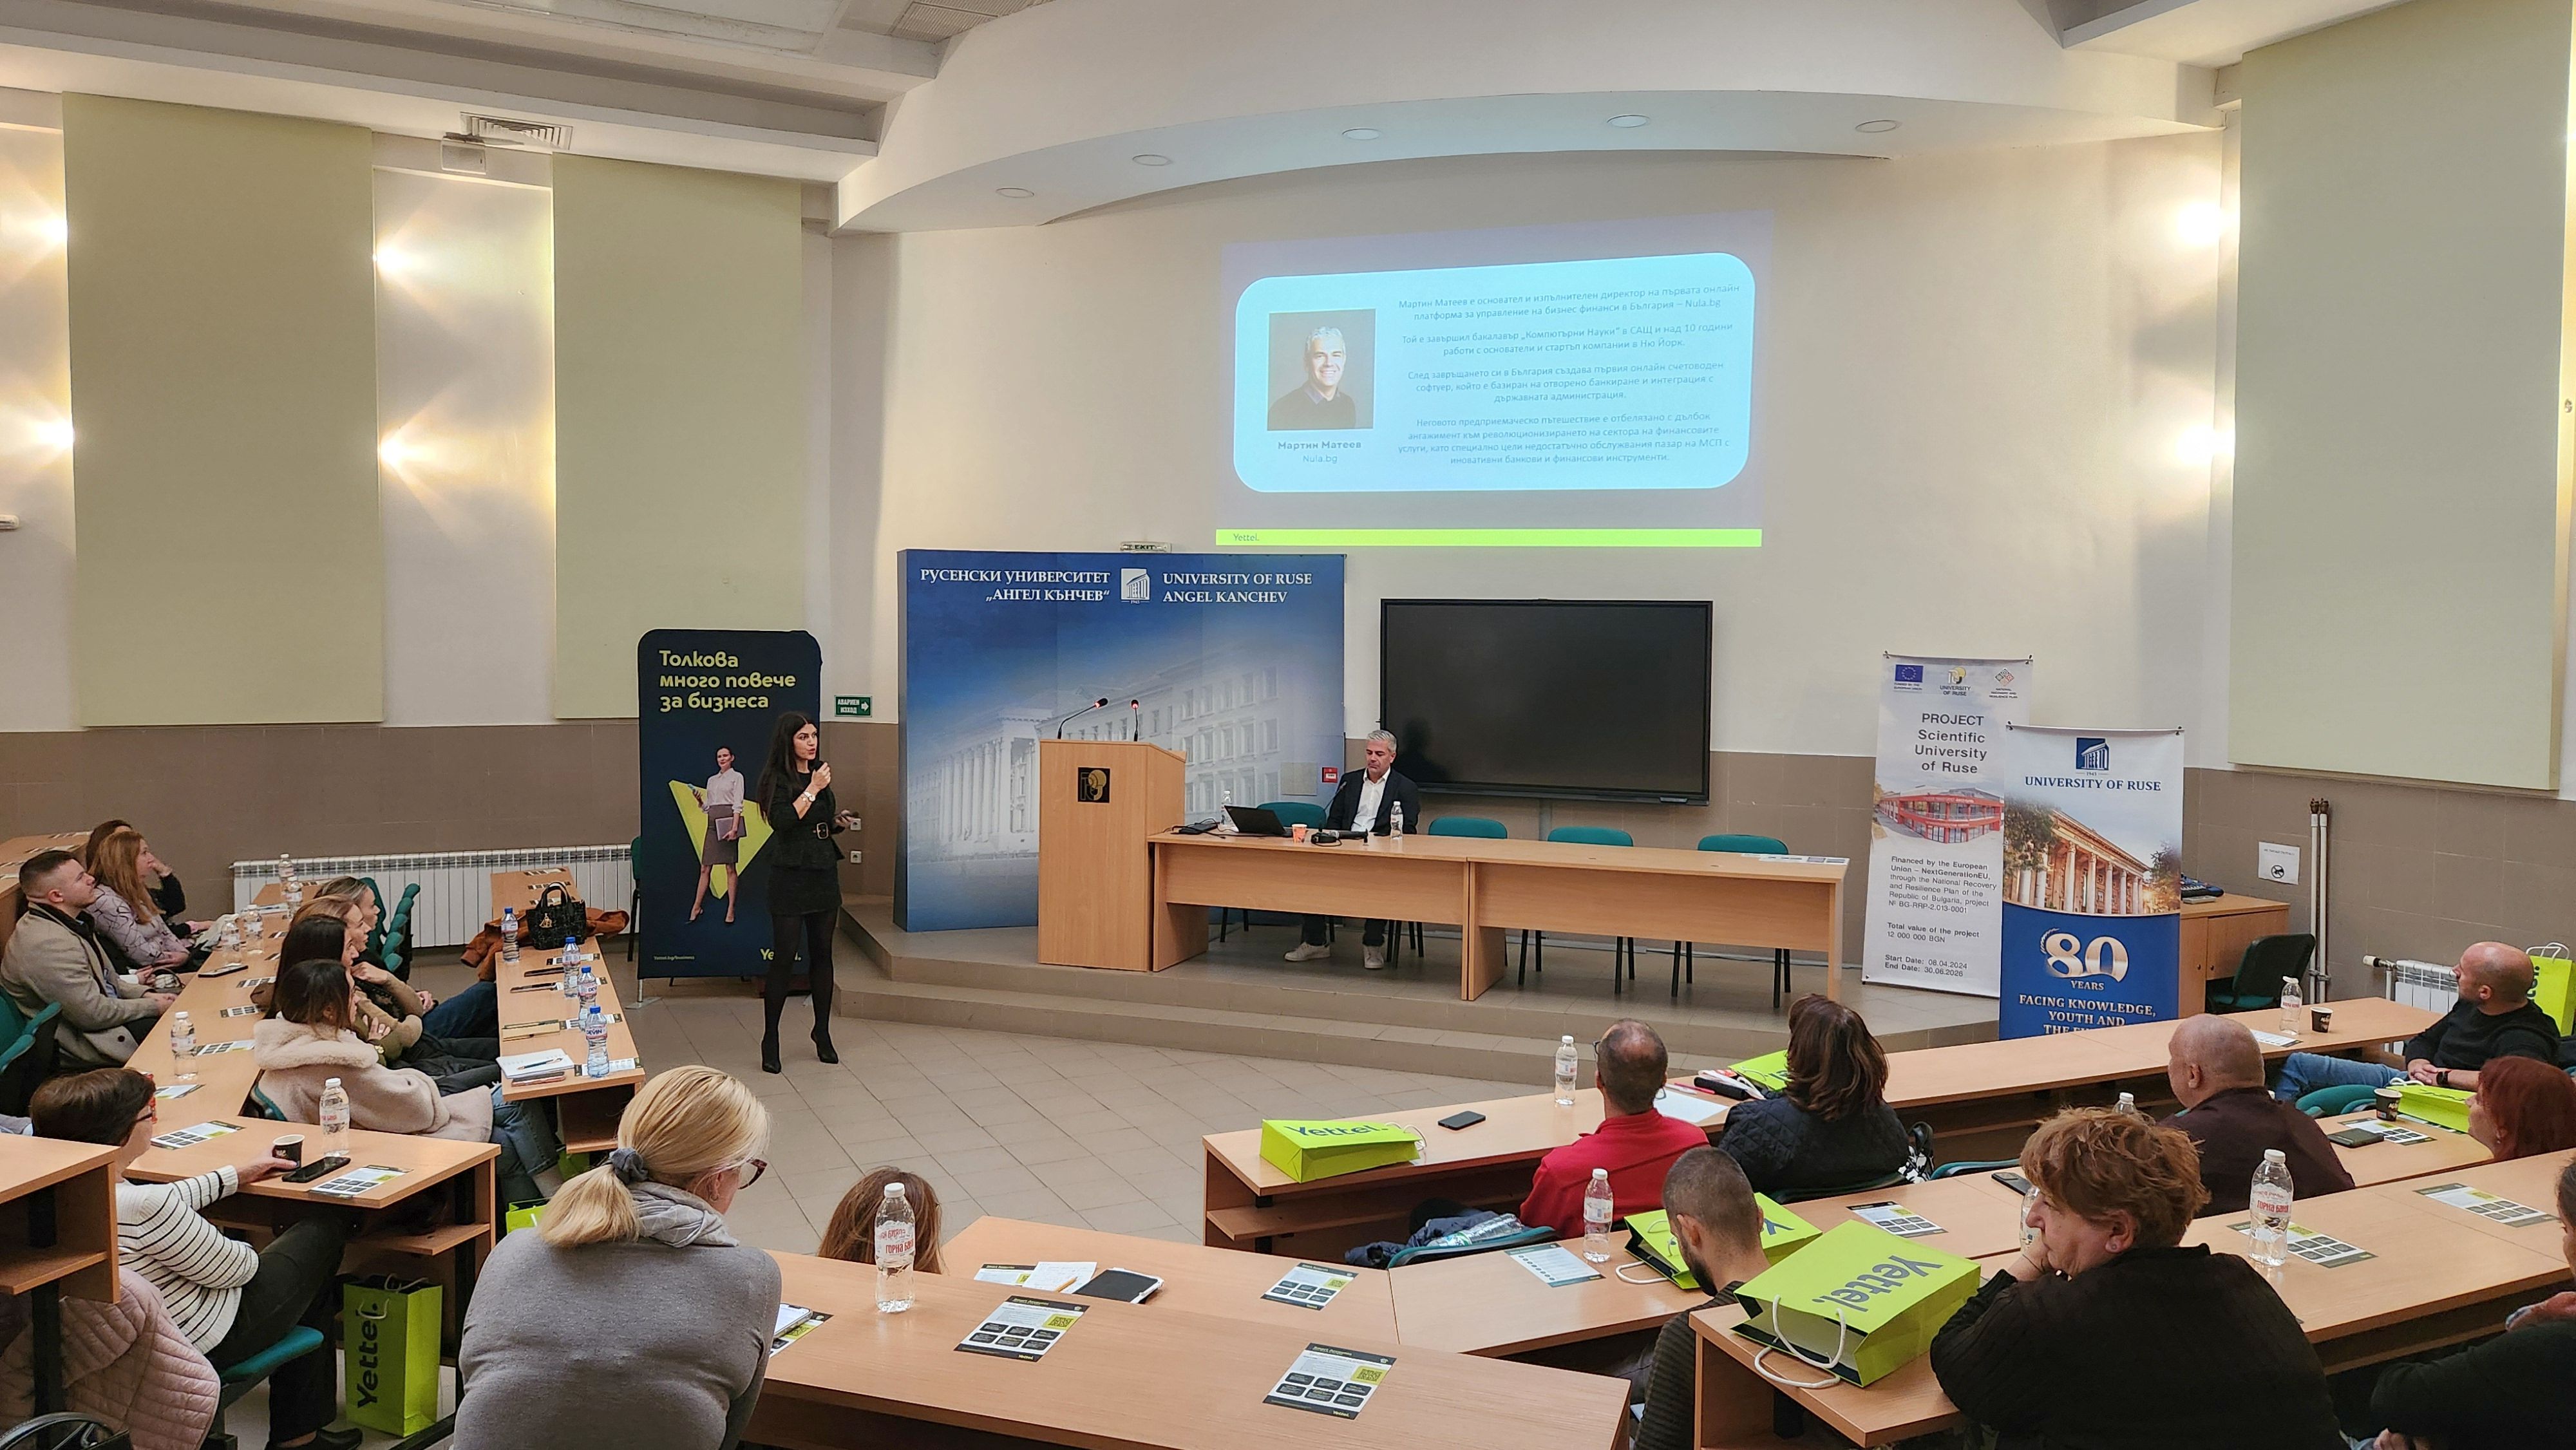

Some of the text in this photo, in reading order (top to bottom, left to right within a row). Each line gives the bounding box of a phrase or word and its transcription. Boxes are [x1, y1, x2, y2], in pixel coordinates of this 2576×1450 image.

[1399, 300, 1432, 309] Мартин
[1477, 296, 1522, 305] основател
[1534, 292, 1598, 303] изпълнителен
[1601, 290, 1645, 300] директор
[1662, 287, 1700, 296] първата
[1703, 284, 1739, 294] онлайн
[1414, 311, 1462, 321] платформа
[1477, 308, 1529, 318] управление
[1546, 305, 1577, 314] бизнес
[1580, 304, 1619, 314] финанси
[1630, 301, 1673, 310] България
[1685, 299, 1720, 308] Nula.bg
[1403, 334, 1416, 343] Той
[1427, 334, 1470, 343] завършил
[1473, 332, 1519, 341] бакалавър
[1630, 326, 1652, 335] САЩ
[1664, 325, 1681, 334] над
[1685, 324, 1695, 332] 10
[1698, 323, 1732, 332] години
[1443, 347, 1473, 356] работи
[1483, 345, 1534, 353] основатели
[1546, 343, 1580, 352] стартъп
[1583, 341, 1629, 350] компании
[1658, 337, 1685, 348] Йорк.
[1408, 371, 1429, 380] След
[1432, 370, 1488, 380] завръщането
[1511, 368, 1553, 377] България
[1555, 367, 1591, 375] създава
[1595, 365, 1627, 374] първия
[1631, 363, 1665, 372] онлайн
[1669, 362, 1723, 371] счетоводен
[1416, 384, 1453, 393] софтуер,
[1456, 382, 1481, 391] който
[1491, 381, 1528, 390] базиран
[1589, 377, 1640, 387] банкиране
[1651, 376, 1705, 386] интеграция
[1494, 391, 1625, 403] държавната администрация.
[1459, 417, 1539, 428] предприемаческо
[1542, 415, 1600, 424] пътешествие
[1611, 414, 1665, 422] отбелязано
[1674, 412, 1710, 422] дълбок
[1278, 442, 1318, 451] Мартин
[1303, 455, 1337, 464] Nula.bg
[921, 569, 1110, 584] РУСЕНСКИ УНИВЕРСИТЕТ
[1163, 574, 1312, 585] UNIVERSITY OF RUSE
[1163, 591, 1288, 602] ANGEL KANCHEV
[659, 650, 738, 667] Толкова
[659, 672, 796, 688] много повече
[660, 692, 768, 712] за бизнеса
[1922, 713, 1984, 726] PROJECT
[1918, 730, 1985, 743] Scientific
[1915, 744, 1987, 761] University
[1922, 761, 1977, 773] of Ruse
[2025, 777, 2161, 791] UNIVERSITY OF RUSE
[1922, 868, 1990, 880] NextGenerationEU,
[1906, 884, 1940, 893] Resilience
[1964, 880, 1996, 890] Recovery
[1932, 896, 1962, 904] Bulgaria,
[1928, 959, 1967, 969] 08.04.2024
[2045, 933, 2128, 983] 80
[2071, 981, 2104, 990] YEARS
[2020, 994, 2156, 1017] FACING KNOWLEDGE,
[2049, 1011, 2125, 1026] YOUTH AND
[1283, 1125, 1388, 1136] Yettel.
[1812, 1256, 1944, 1312] Yettel.
[356, 1303, 378, 1408] Yettel.
